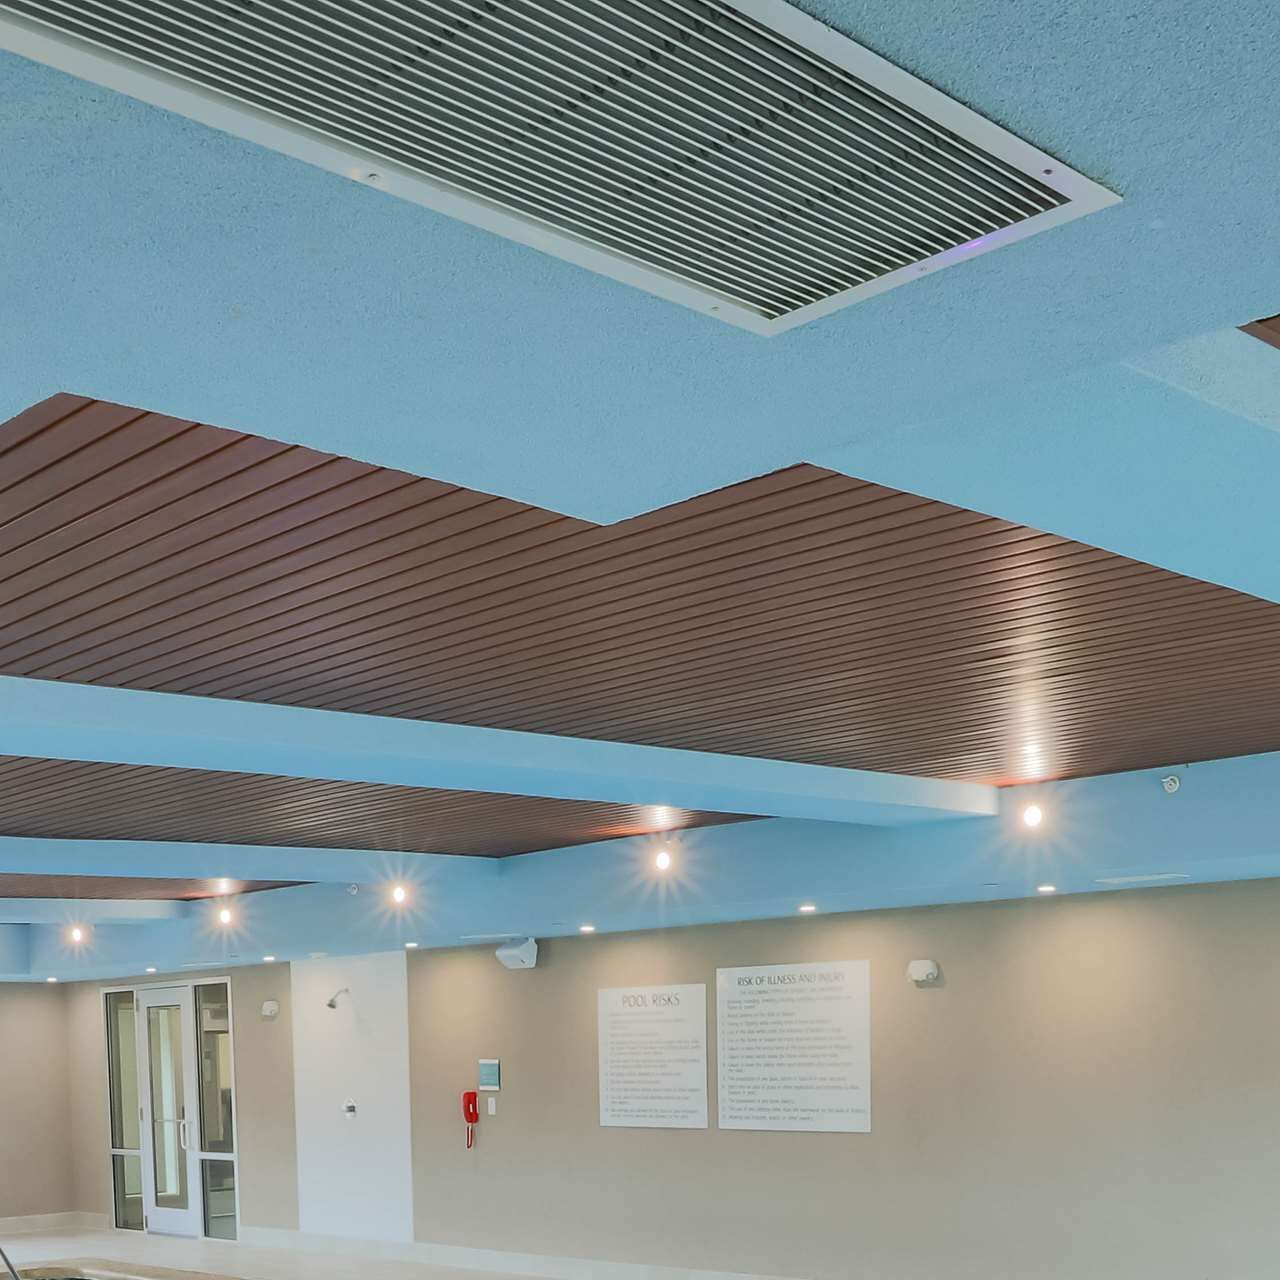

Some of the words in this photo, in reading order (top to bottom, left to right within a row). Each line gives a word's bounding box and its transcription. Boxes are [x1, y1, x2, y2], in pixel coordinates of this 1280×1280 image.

[737, 976, 754, 987] RISK
[755, 976, 766, 986] OF
[767, 974, 797, 986] ILLNESS
[622, 993, 649, 1008] POOL
[652, 991, 681, 1007] RISKS
